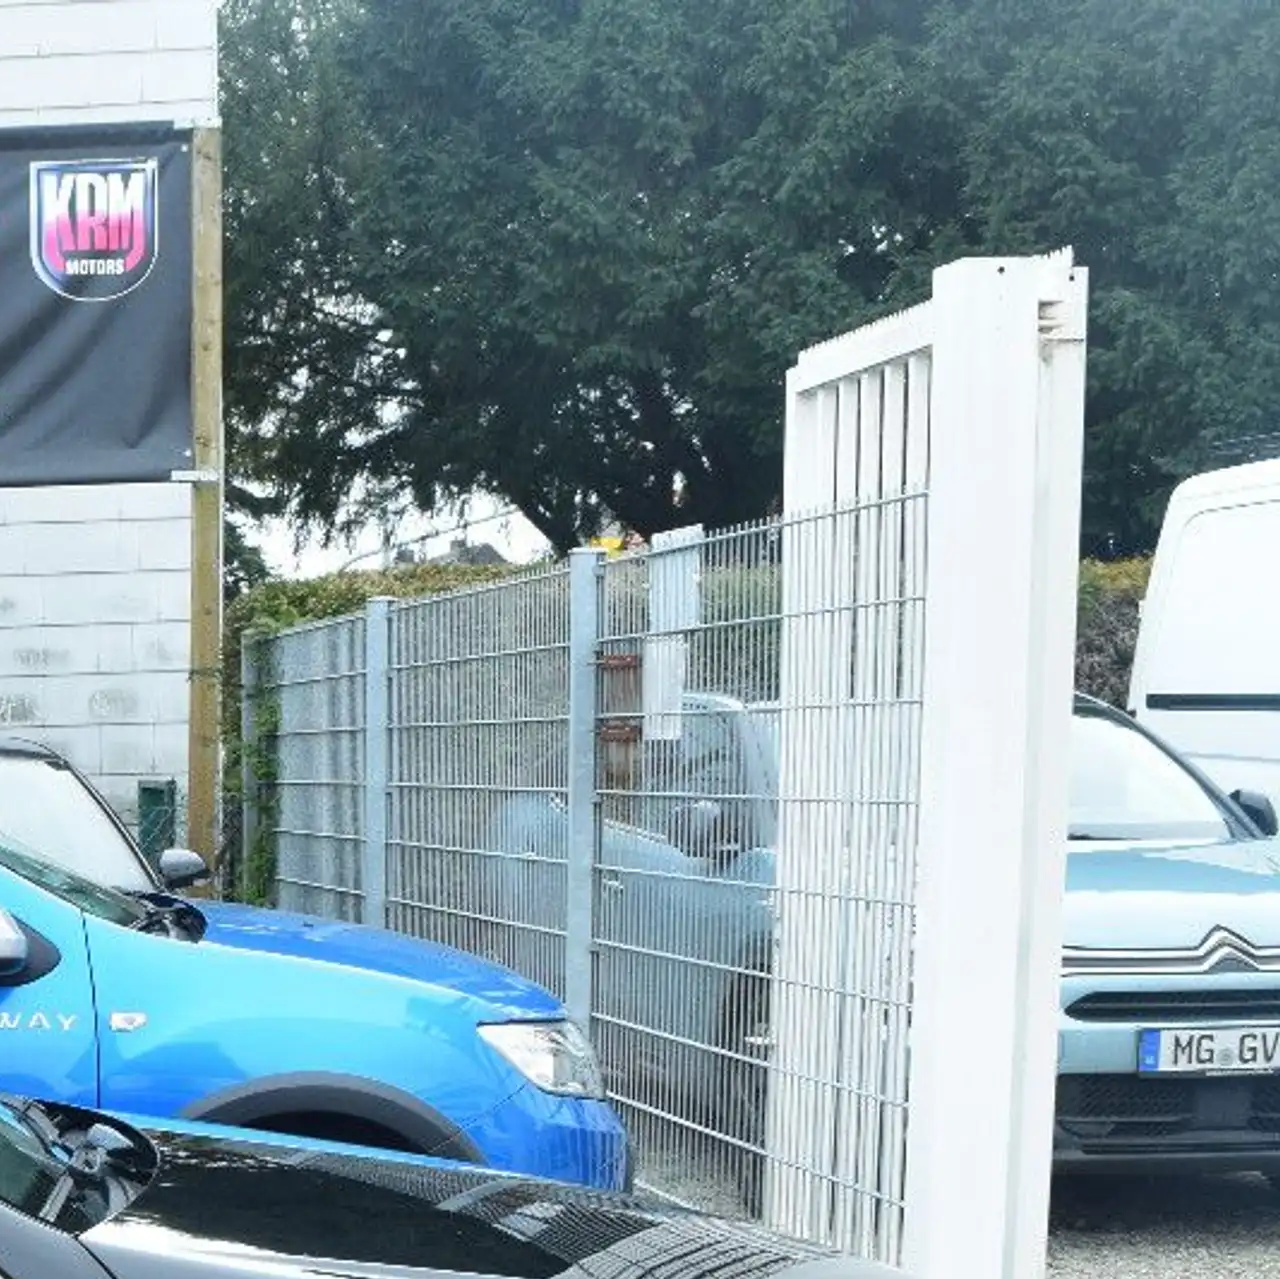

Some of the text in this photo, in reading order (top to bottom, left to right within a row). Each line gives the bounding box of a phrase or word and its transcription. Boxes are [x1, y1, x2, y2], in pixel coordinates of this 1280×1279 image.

[43, 172, 146, 251] KRM
[65, 257, 126, 276] MOTORS
[1172, 1033, 1215, 1065] MG
